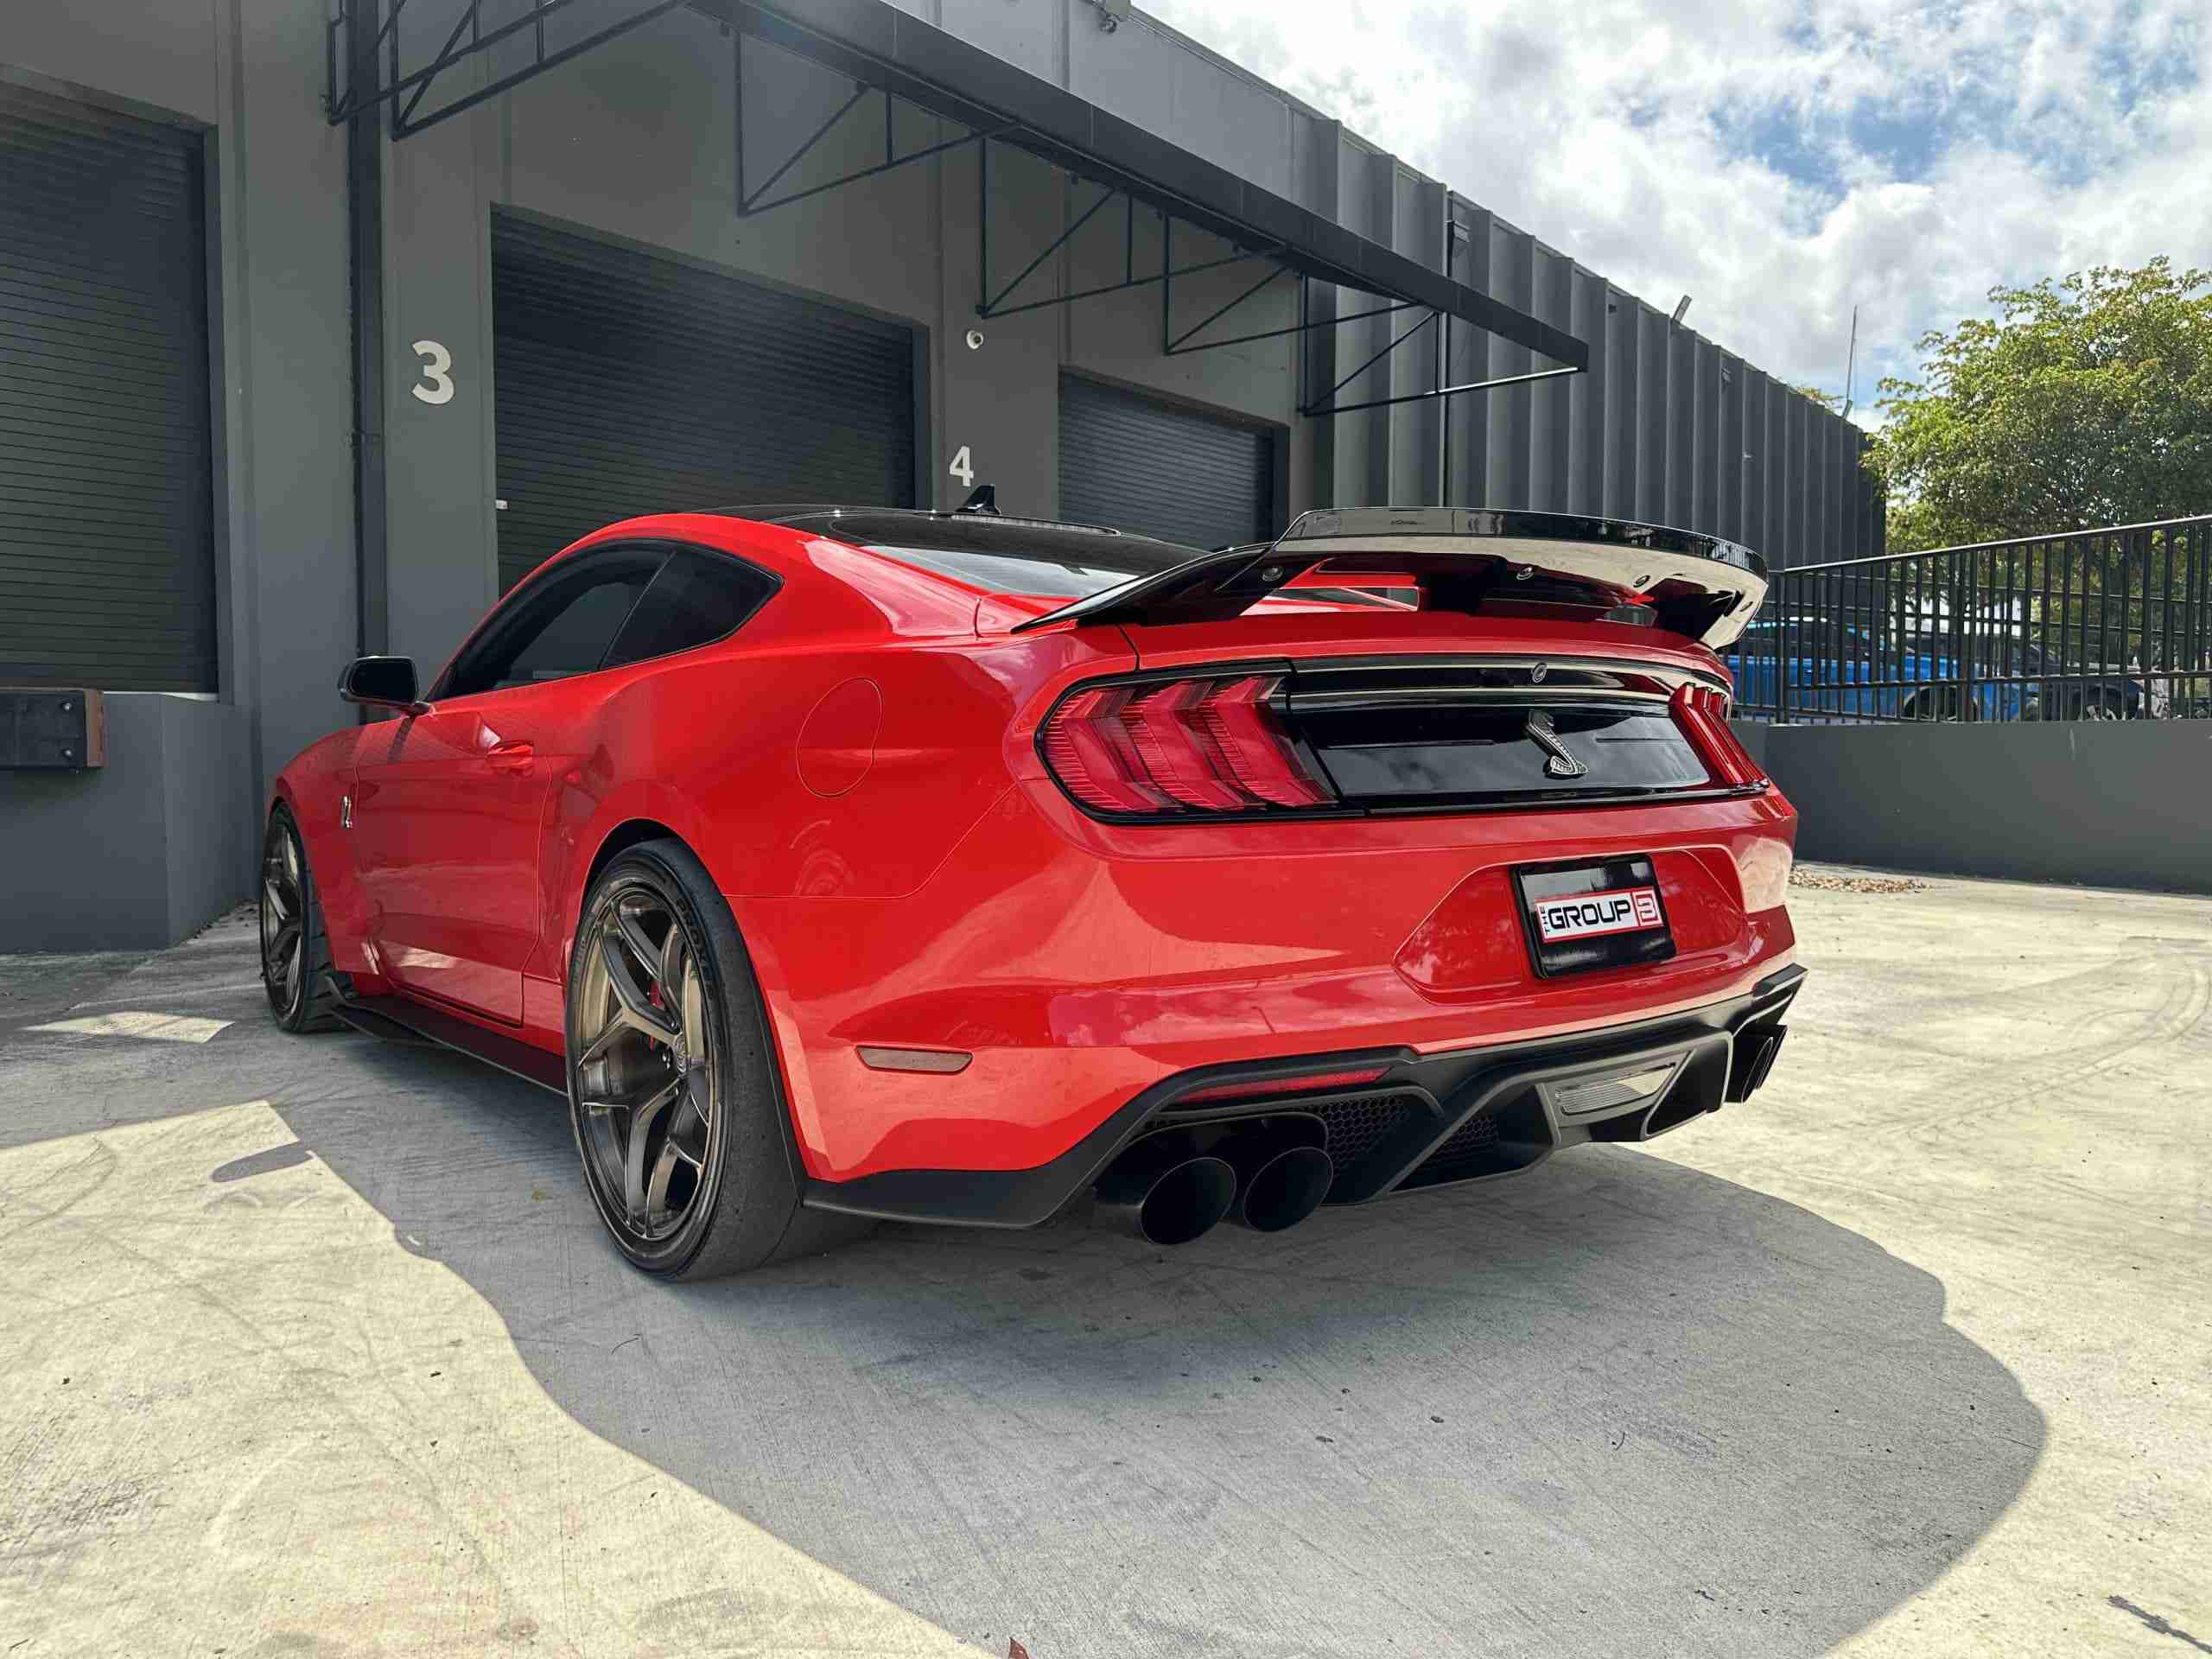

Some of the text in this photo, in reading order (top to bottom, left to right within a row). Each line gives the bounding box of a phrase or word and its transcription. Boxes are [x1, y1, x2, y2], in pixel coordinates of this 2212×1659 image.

[412, 340, 454, 404] 3
[950, 446, 974, 486] 4
[1548, 899, 1631, 930] GROUP
